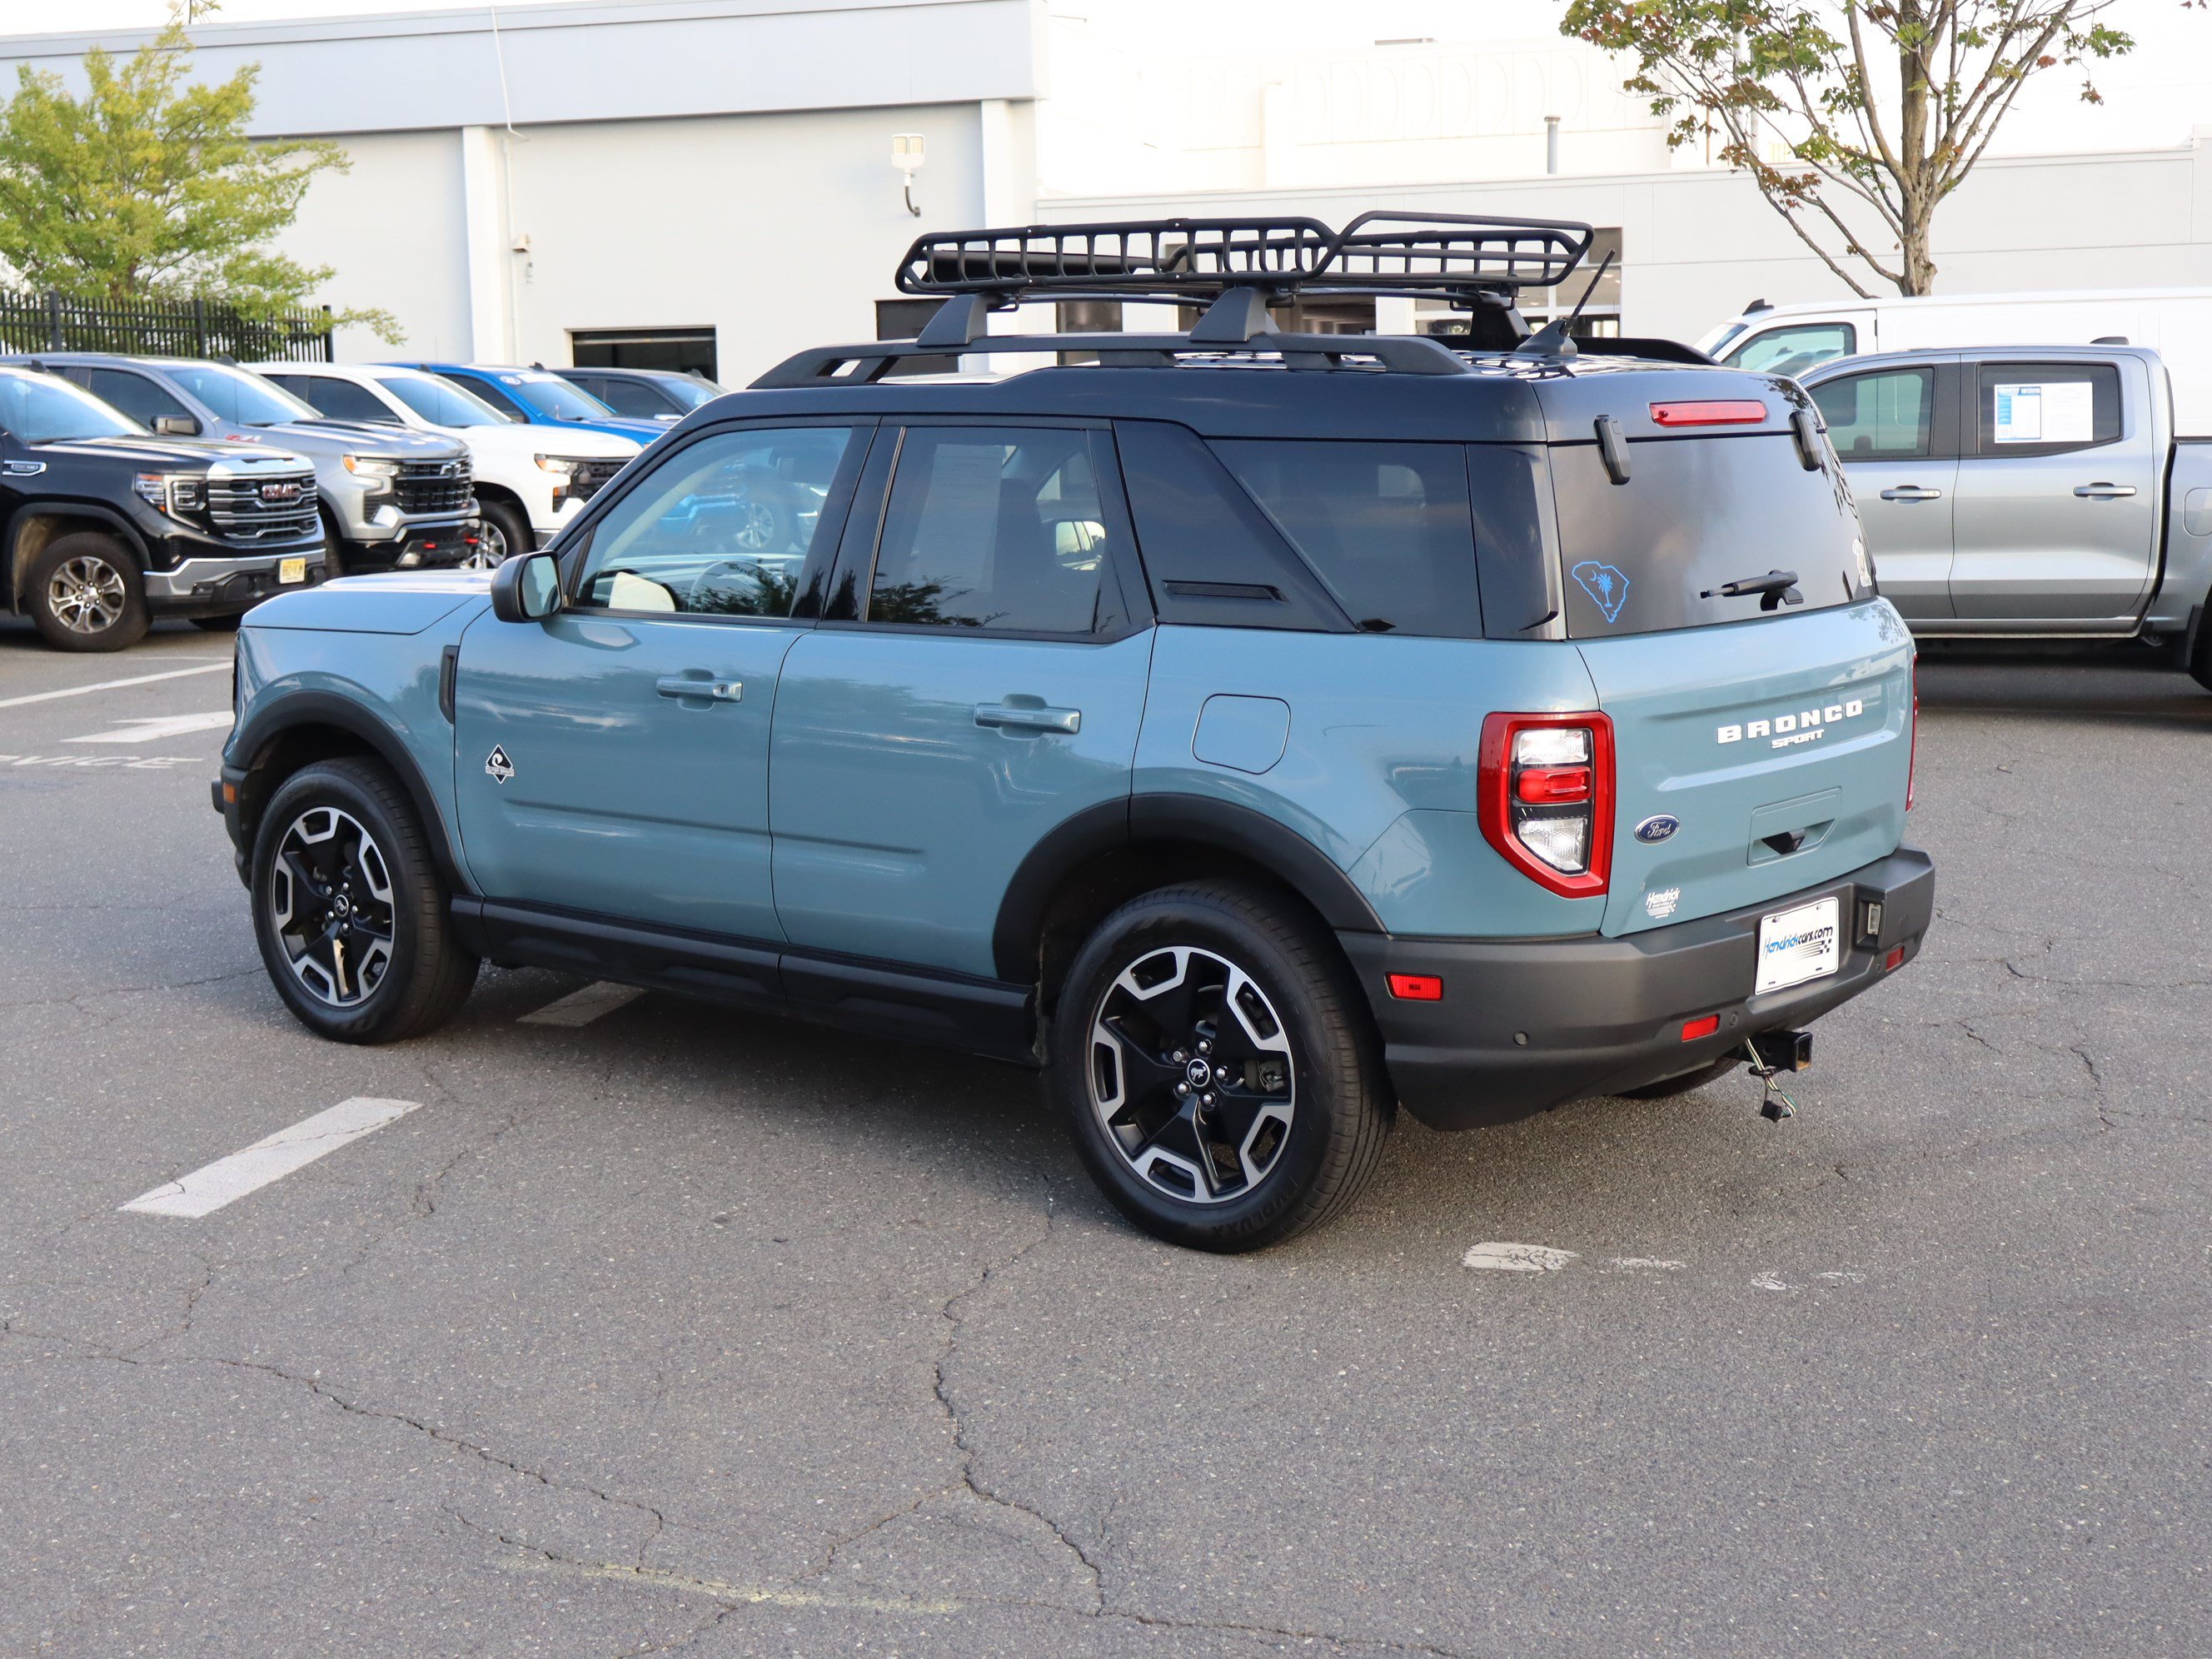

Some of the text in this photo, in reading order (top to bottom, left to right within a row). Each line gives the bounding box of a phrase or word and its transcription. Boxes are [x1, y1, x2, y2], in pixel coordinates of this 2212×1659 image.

[262, 483, 301, 500] GMC
[1716, 699, 1863, 745] BRONCO
[1771, 729, 1825, 750] SPORT
[0, 755, 205, 770] VICE
[1647, 820, 1671, 839] Ford
[1646, 887, 1680, 909] Hendrick
